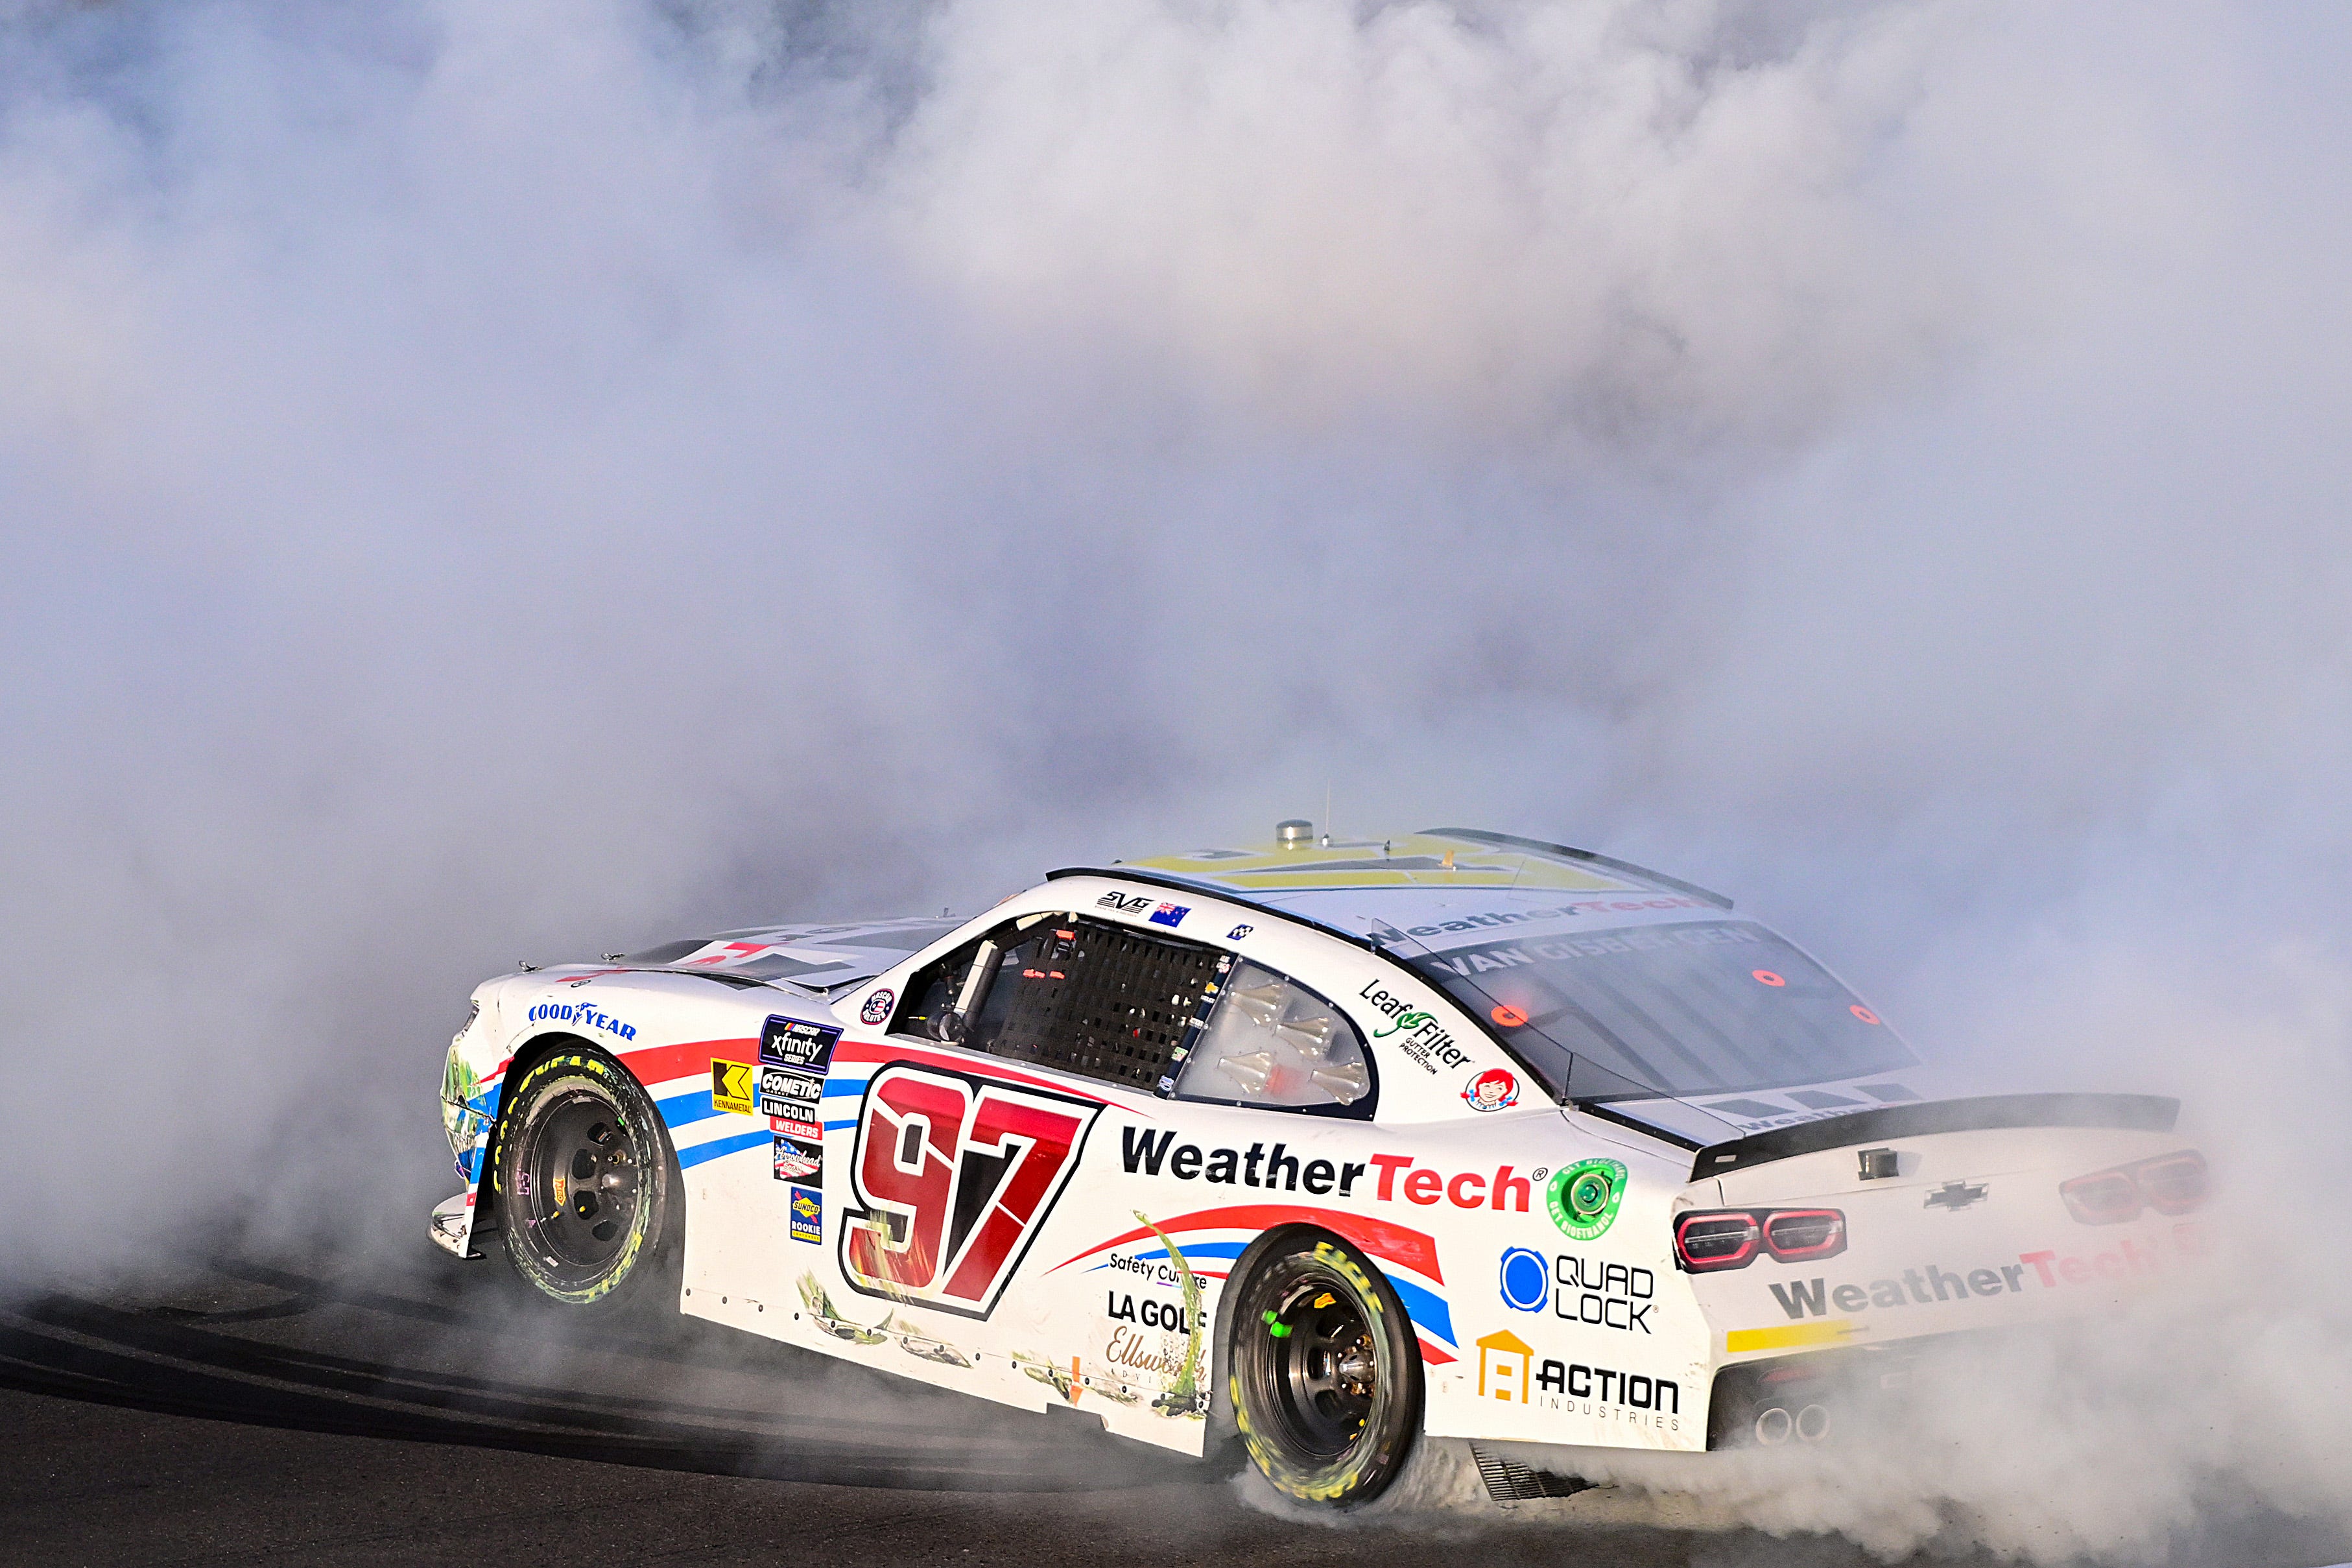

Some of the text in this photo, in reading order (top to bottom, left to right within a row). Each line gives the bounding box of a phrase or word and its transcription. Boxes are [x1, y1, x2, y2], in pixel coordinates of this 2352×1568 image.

[1101, 891, 1154, 909] SVG
[1431, 947, 1535, 976] VAN
[772, 1032, 823, 1062] xfinity
[1399, 1043, 1438, 1075] PROTECTION
[1405, 1037, 1430, 1058] GUTTER
[762, 1074, 821, 1099] COMETIC
[714, 1099, 751, 1113] KENNAMETAL
[764, 1100, 813, 1122] LINCOLN
[776, 1123, 818, 1138] WELDERS
[774, 1146, 820, 1167] Arrowhead
[843, 1067, 1097, 1314] 97
[794, 1202, 818, 1214] SUNOCO
[792, 1221, 820, 1235] ROOKIE
[1560, 1213, 1613, 1239] BIOETHANOL
[1110, 1253, 1154, 1281] Safety
[1556, 1255, 1653, 1299] QUAD
[1108, 1290, 1136, 1323] LA
[1540, 1396, 1678, 1431] INDUSTRIES
